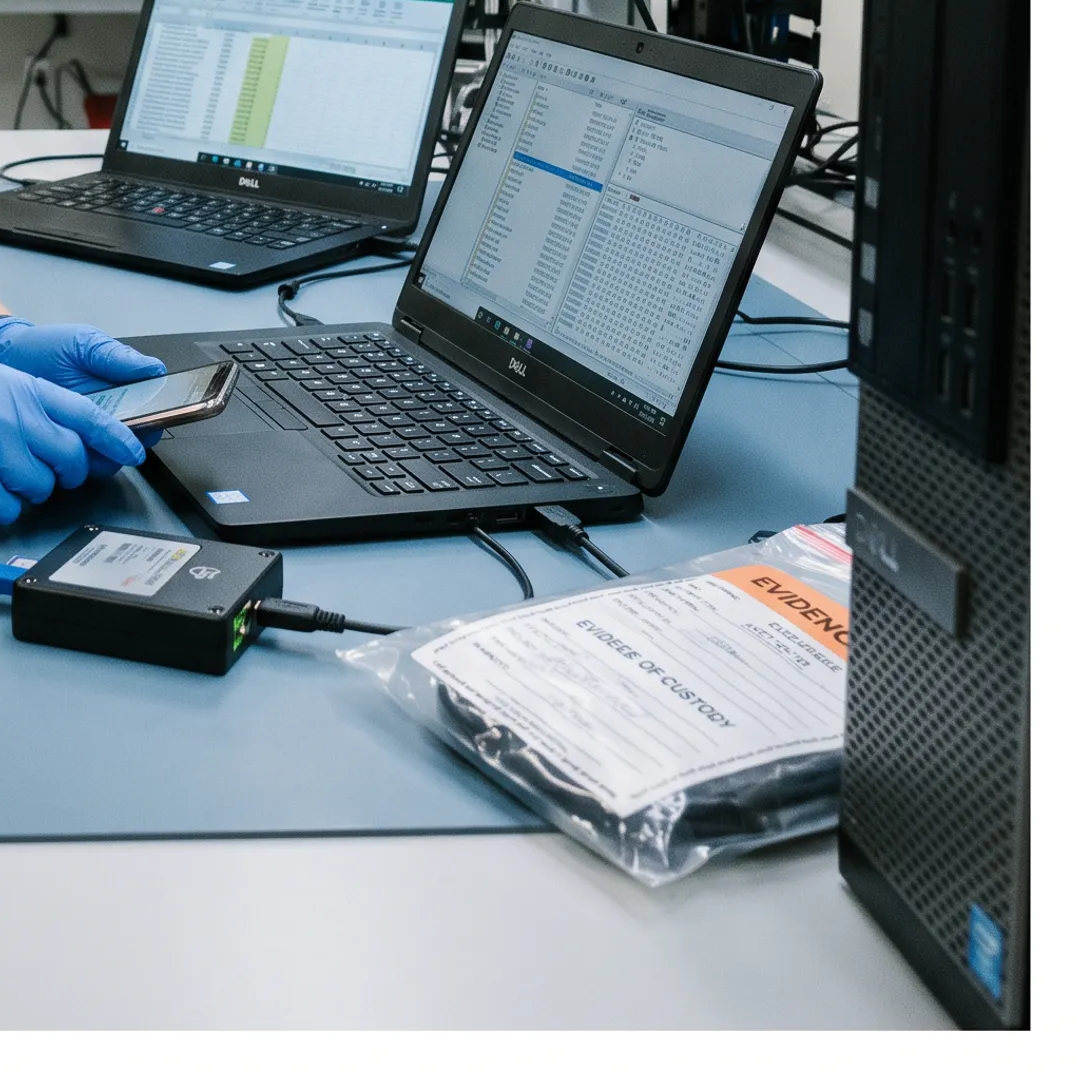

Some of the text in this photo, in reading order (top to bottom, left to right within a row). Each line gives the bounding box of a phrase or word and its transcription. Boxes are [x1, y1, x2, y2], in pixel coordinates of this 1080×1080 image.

[238, 176, 260, 188] DELL
[508, 357, 527, 377] DELL
[638, 660, 666, 677] OF
[660, 676, 737, 728] CUSTODY
